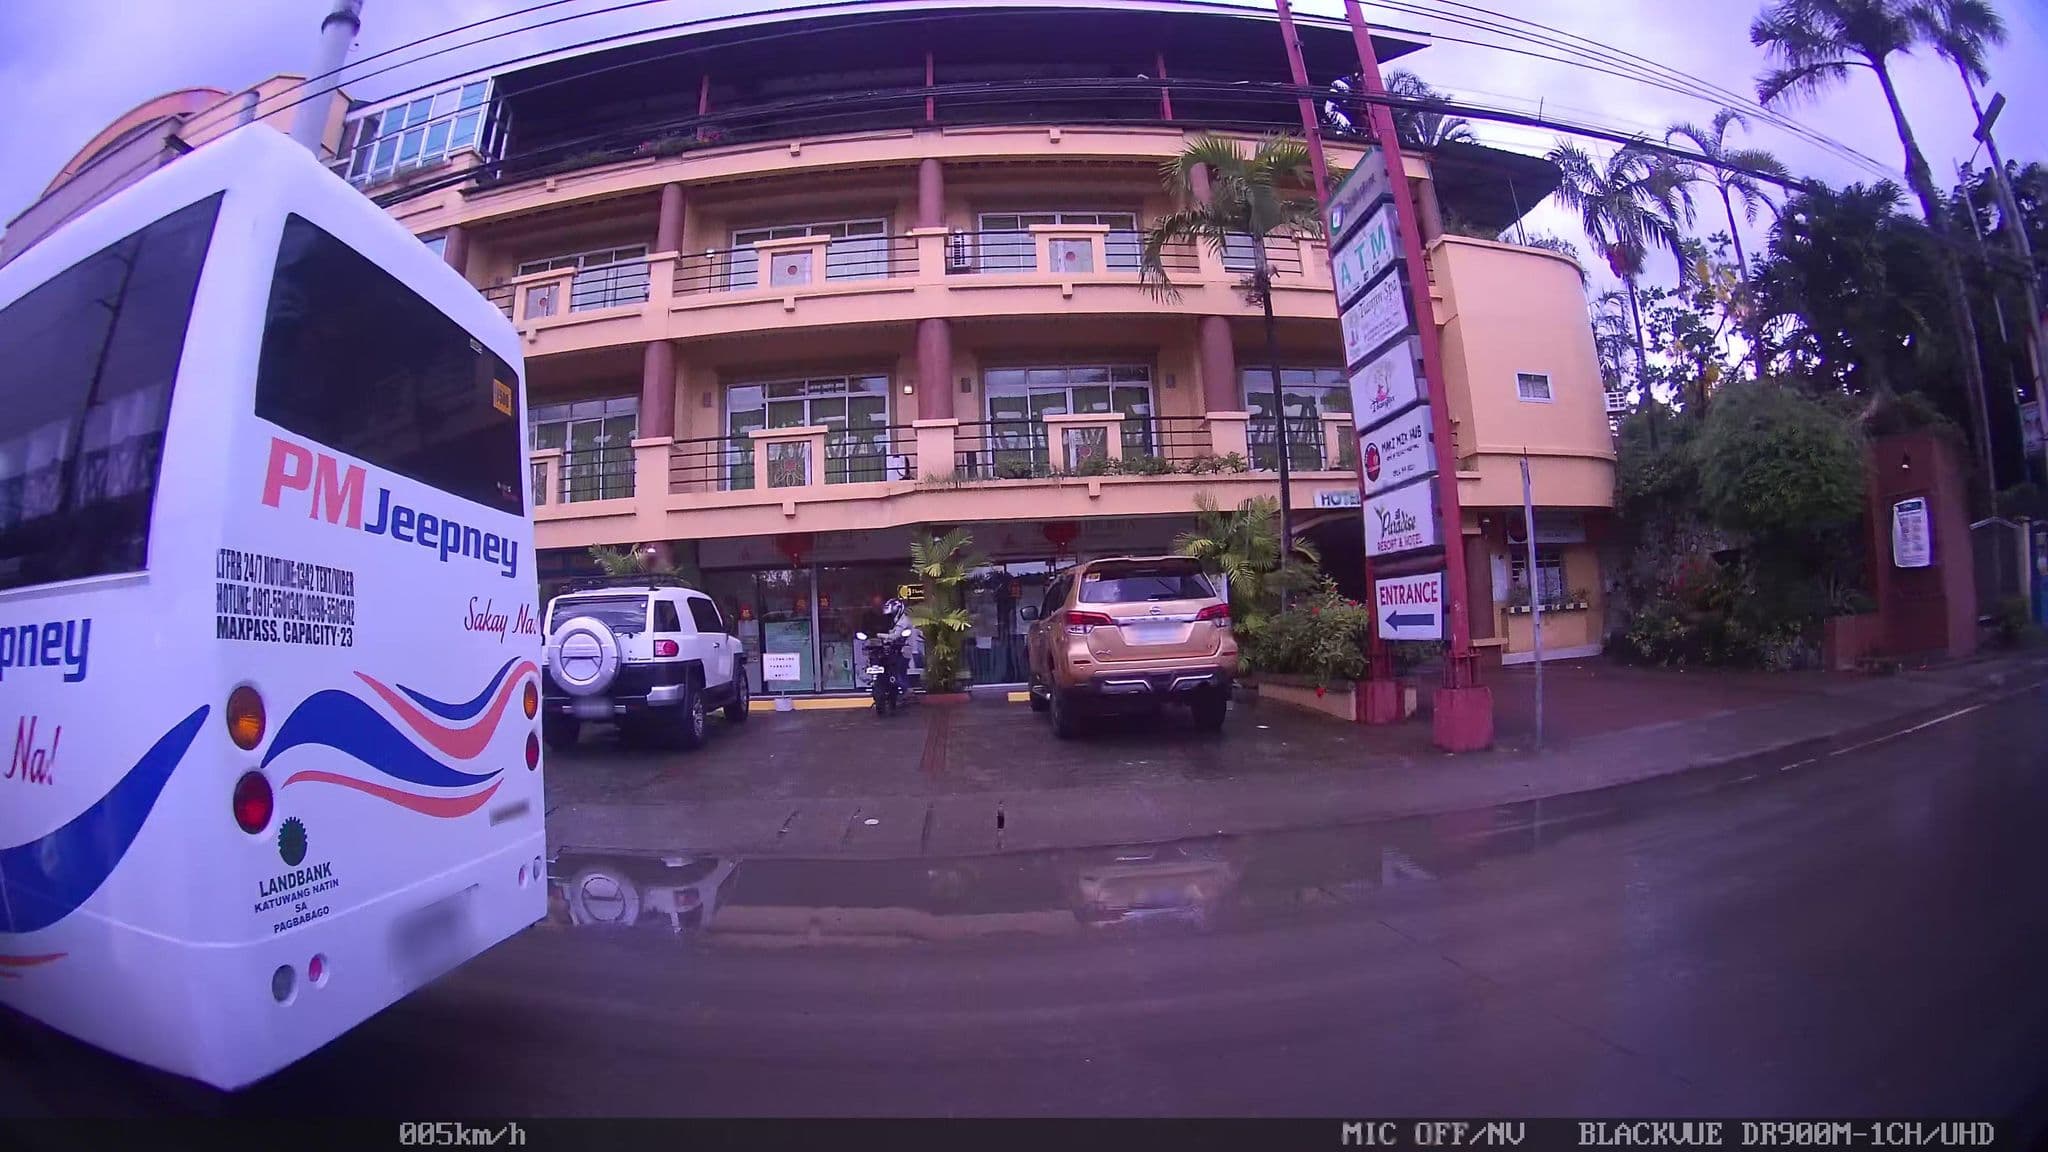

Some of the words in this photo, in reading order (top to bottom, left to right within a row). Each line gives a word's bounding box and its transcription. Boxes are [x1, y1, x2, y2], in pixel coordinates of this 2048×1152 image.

[1341, 222, 1386, 289] ATM
[1409, 424, 1422, 439] HUB
[1381, 511, 1416, 540] Paradise
[1377, 539, 1398, 552] RESORT
[1405, 533, 1423, 546] HOTEL
[216, 548, 242, 581] LTFRB
[244, 552, 262, 583] 24/7
[1380, 581, 1438, 606] ENTRANCE
[464, 596, 508, 644] Sakay
[5, 715, 62, 786] Na!
[254, 888, 311, 913] KATUWANG
[312, 878, 339, 894] NATIN
[259, 861, 332, 898] LANDBANK
[273, 906, 329, 933] PAGBABAGO
[295, 902, 308, 913] SA
